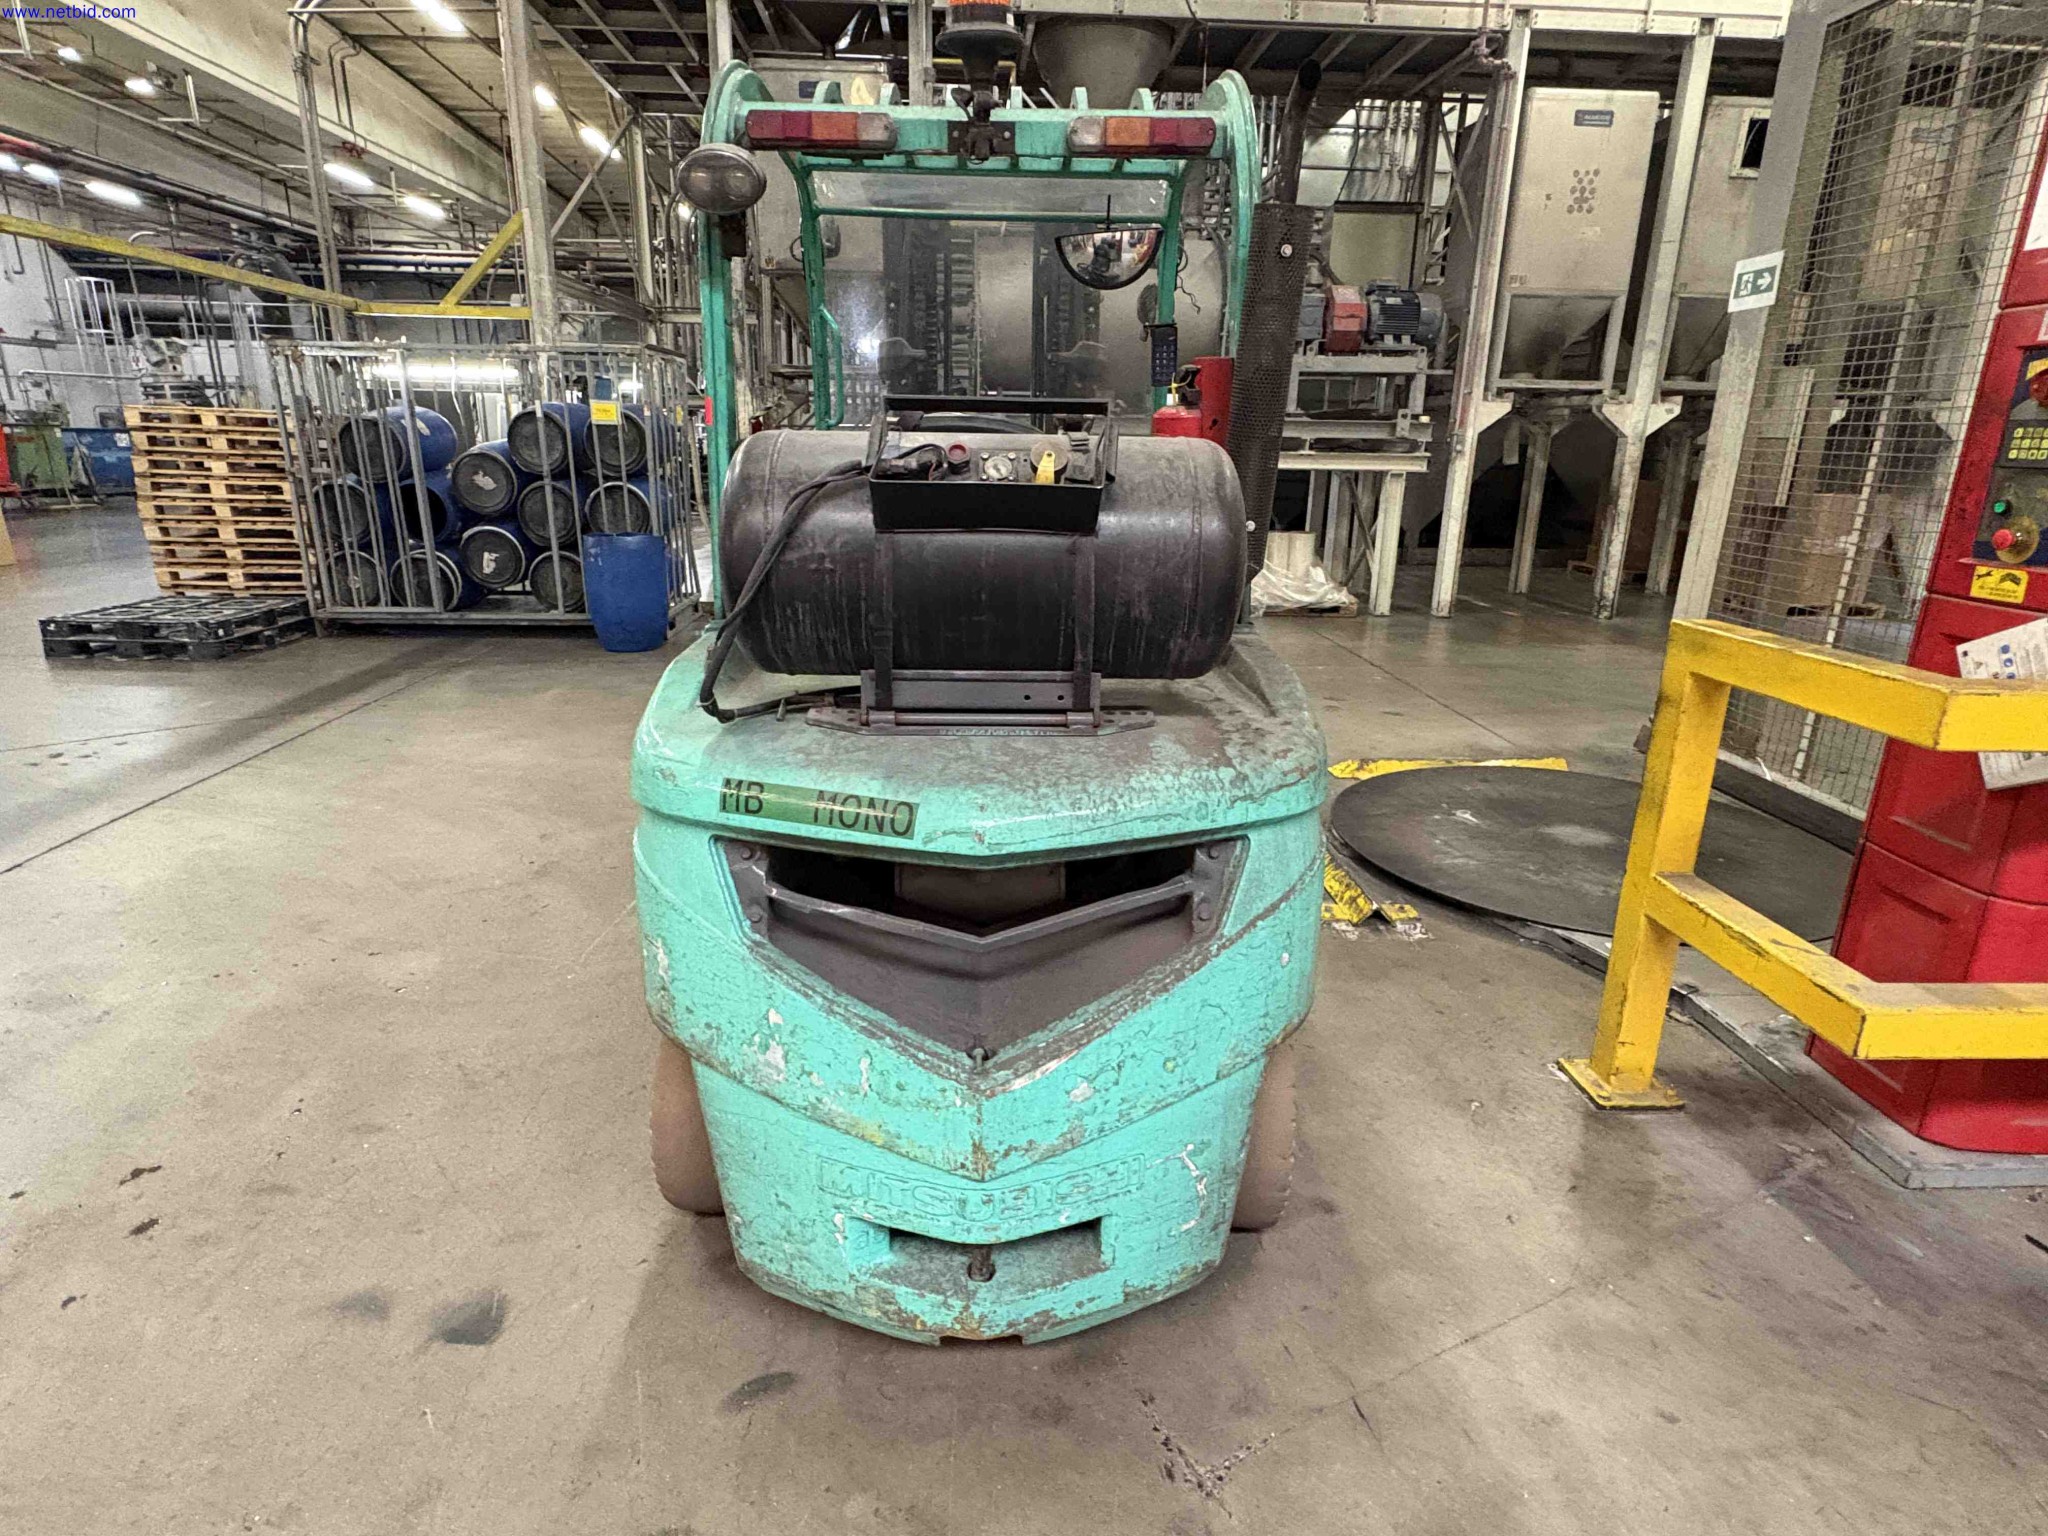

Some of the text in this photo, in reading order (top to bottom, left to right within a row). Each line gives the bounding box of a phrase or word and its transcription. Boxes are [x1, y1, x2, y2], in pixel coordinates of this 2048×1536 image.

[721, 778, 914, 836] MB MONO
[819, 1154, 1146, 1222] MITSUBISHI
